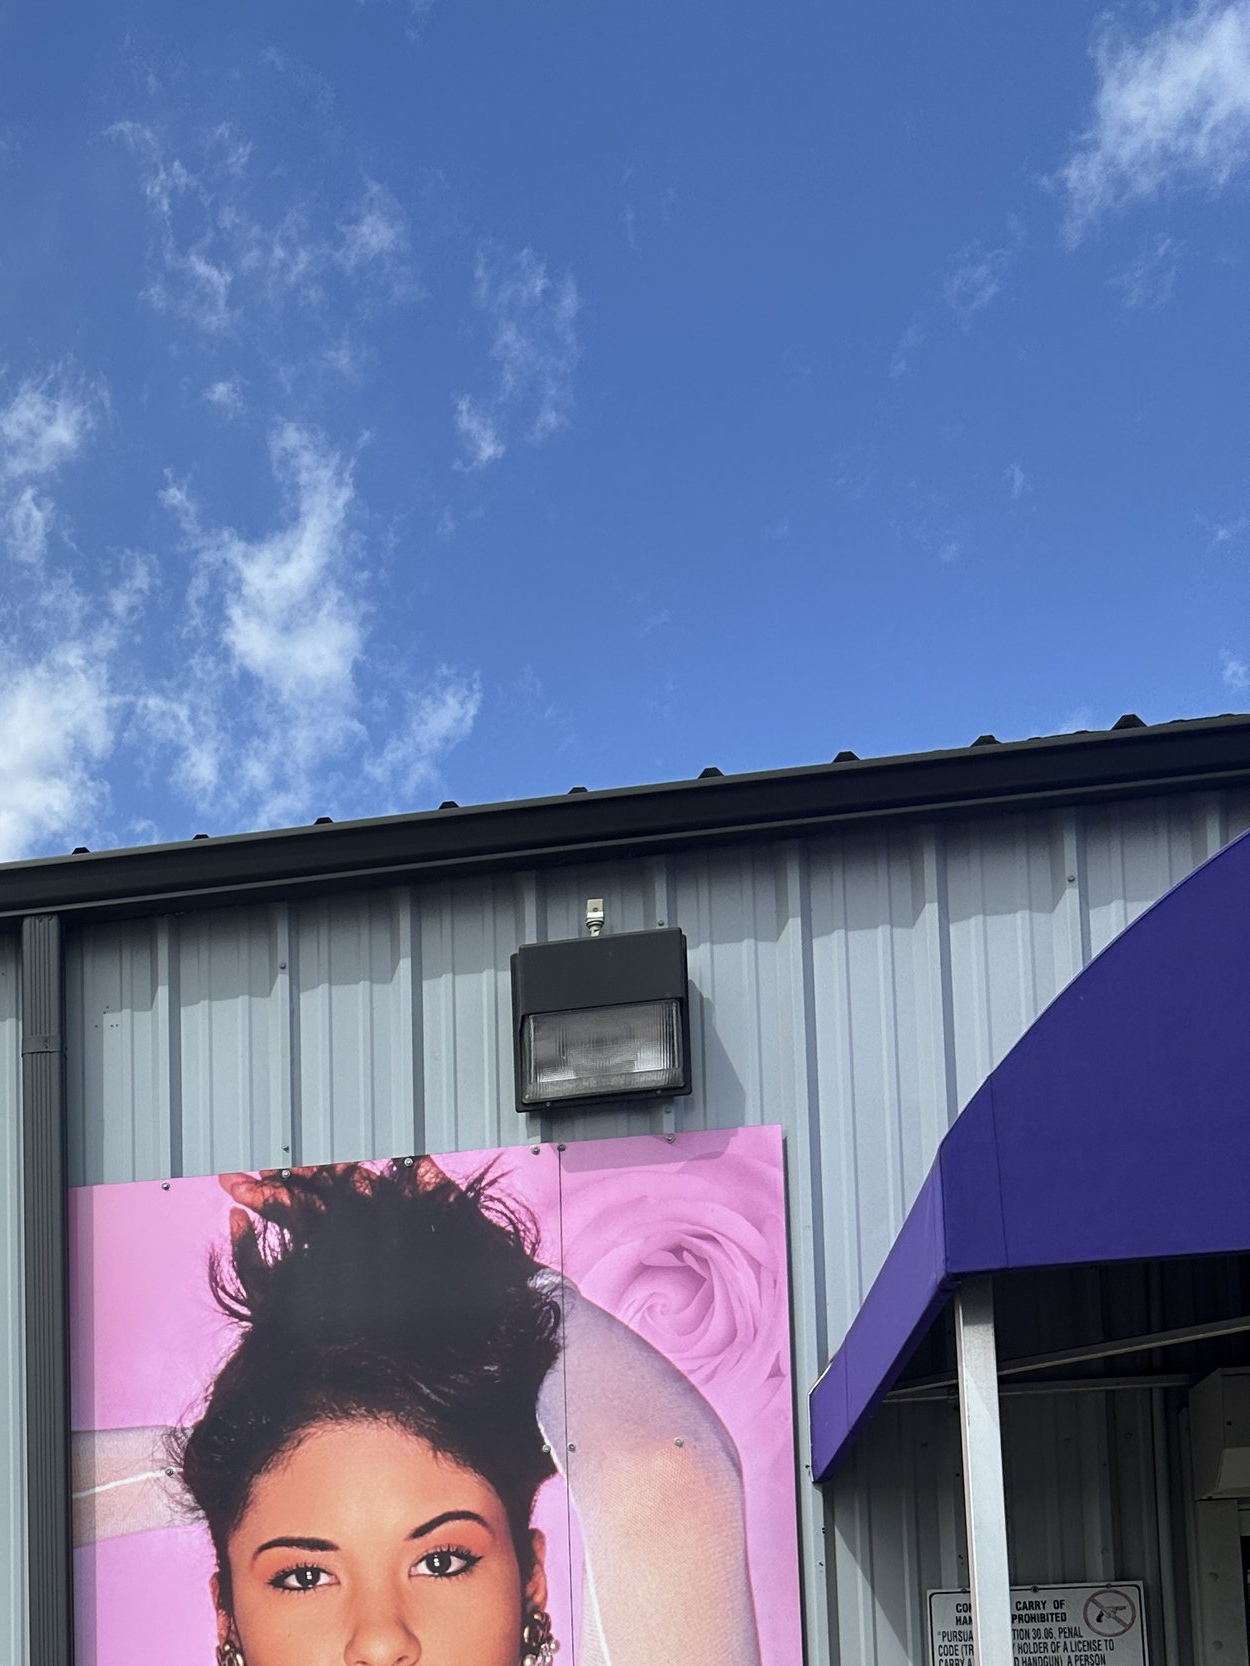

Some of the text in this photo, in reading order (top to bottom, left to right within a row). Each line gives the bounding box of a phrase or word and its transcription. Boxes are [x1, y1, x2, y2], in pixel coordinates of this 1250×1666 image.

[1015, 1600, 1065, 1611] CARRY OF
[1011, 1612, 1067, 1624] PROHIBITED
[937, 1630, 974, 1643] "PURSUA
[1058, 1626, 1083, 1639] PENAL
[938, 1644, 959, 1657] CODE
[1017, 1641, 1049, 1655] HOLDER
[1050, 1641, 1061, 1653] OF
[1063, 1641, 1069, 1653] A
[1070, 1639, 1102, 1653] LICENSE
[1104, 1639, 1115, 1651] TO
[1067, 1655, 1073, 1666] A
[1075, 1654, 1106, 1666] PERSON
